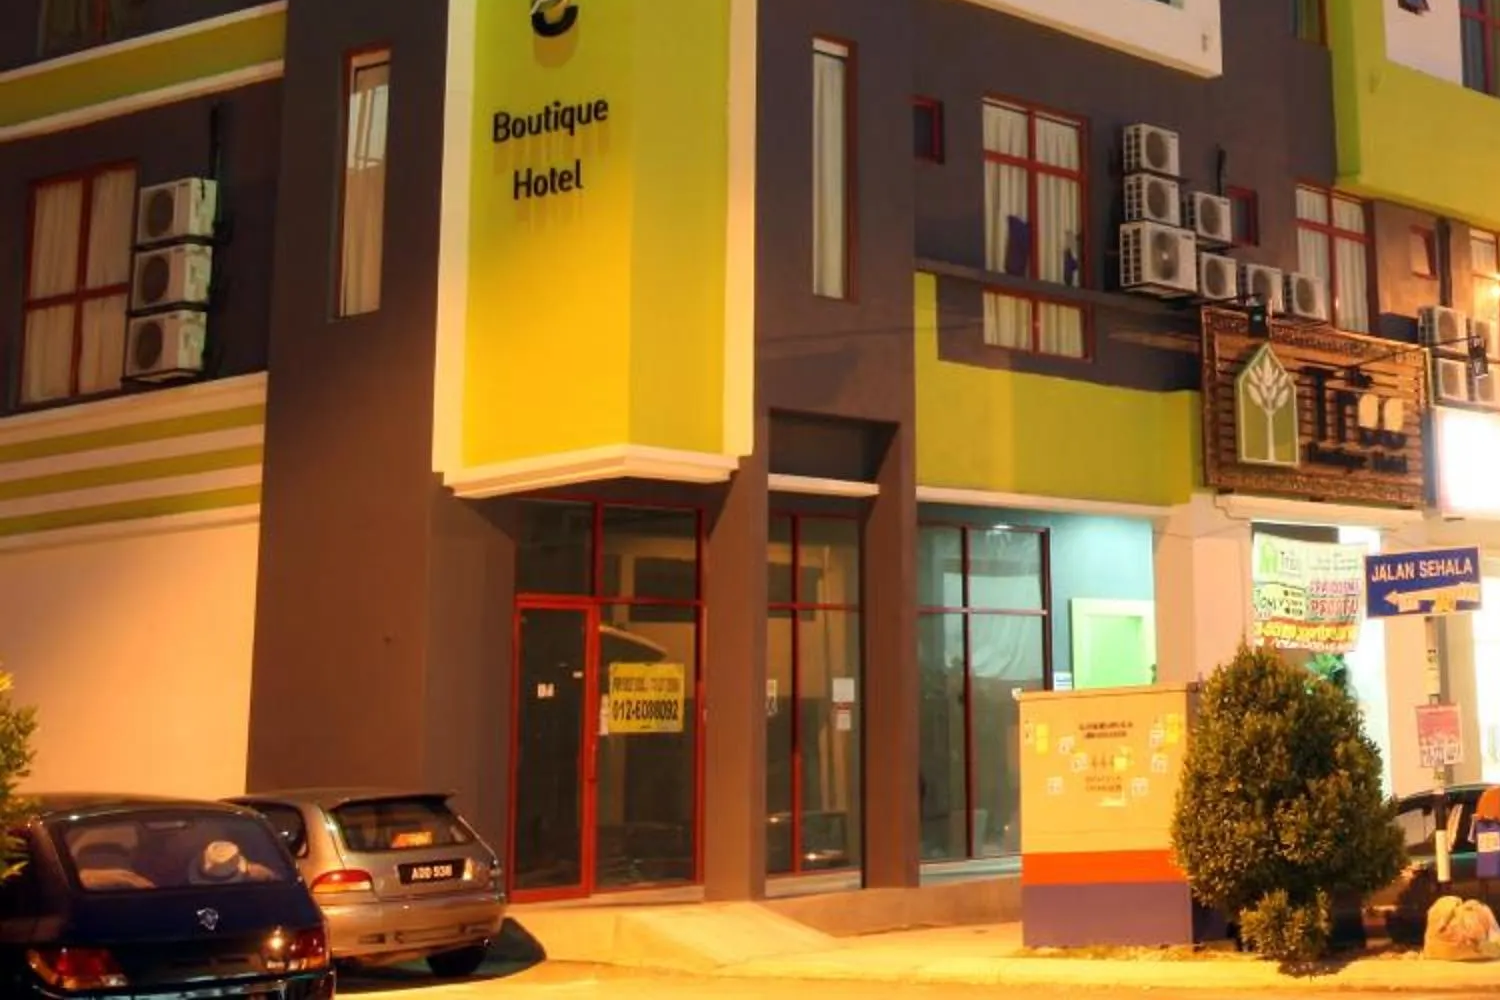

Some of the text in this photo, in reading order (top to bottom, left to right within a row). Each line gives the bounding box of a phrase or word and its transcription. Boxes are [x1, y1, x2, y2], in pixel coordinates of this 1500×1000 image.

[493, 99, 609, 144] Boutique
[513, 158, 584, 201] Hotel
[1371, 561, 1415, 583] JALAN
[1418, 557, 1474, 580] SEHALA
